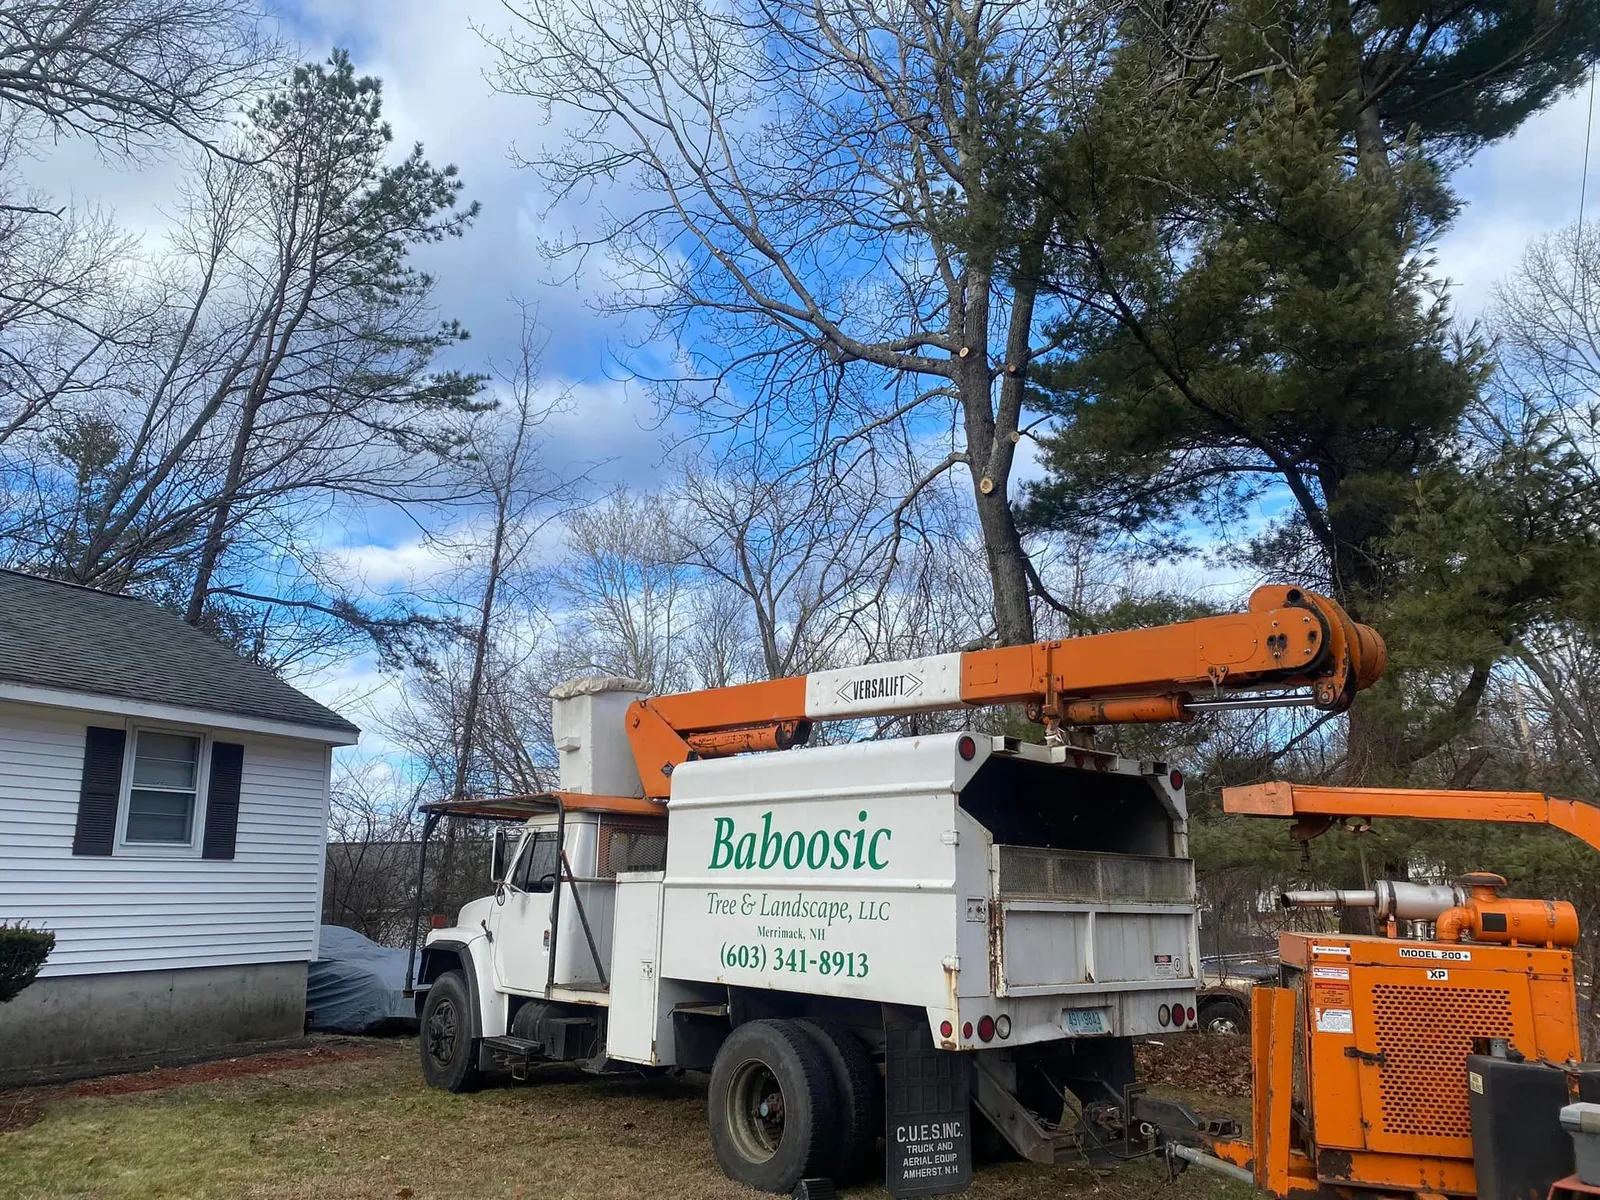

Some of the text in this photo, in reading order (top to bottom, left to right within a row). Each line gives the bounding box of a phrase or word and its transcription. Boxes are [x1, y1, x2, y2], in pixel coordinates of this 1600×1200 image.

[853, 675, 904, 700] VERSALIFT
[707, 810, 892, 870] Baboosic
[707, 892, 891, 926] Tree & Landscape, LLC
[757, 925, 826, 941] Merrimack, NH
[720, 941, 869, 978] (603) 341-8913
[1401, 949, 1437, 958] MODEL
[1430, 970, 1446, 979] XP
[906, 1141, 953, 1154] TRUCK AND
[903, 1156, 933, 1167] AERIAL
